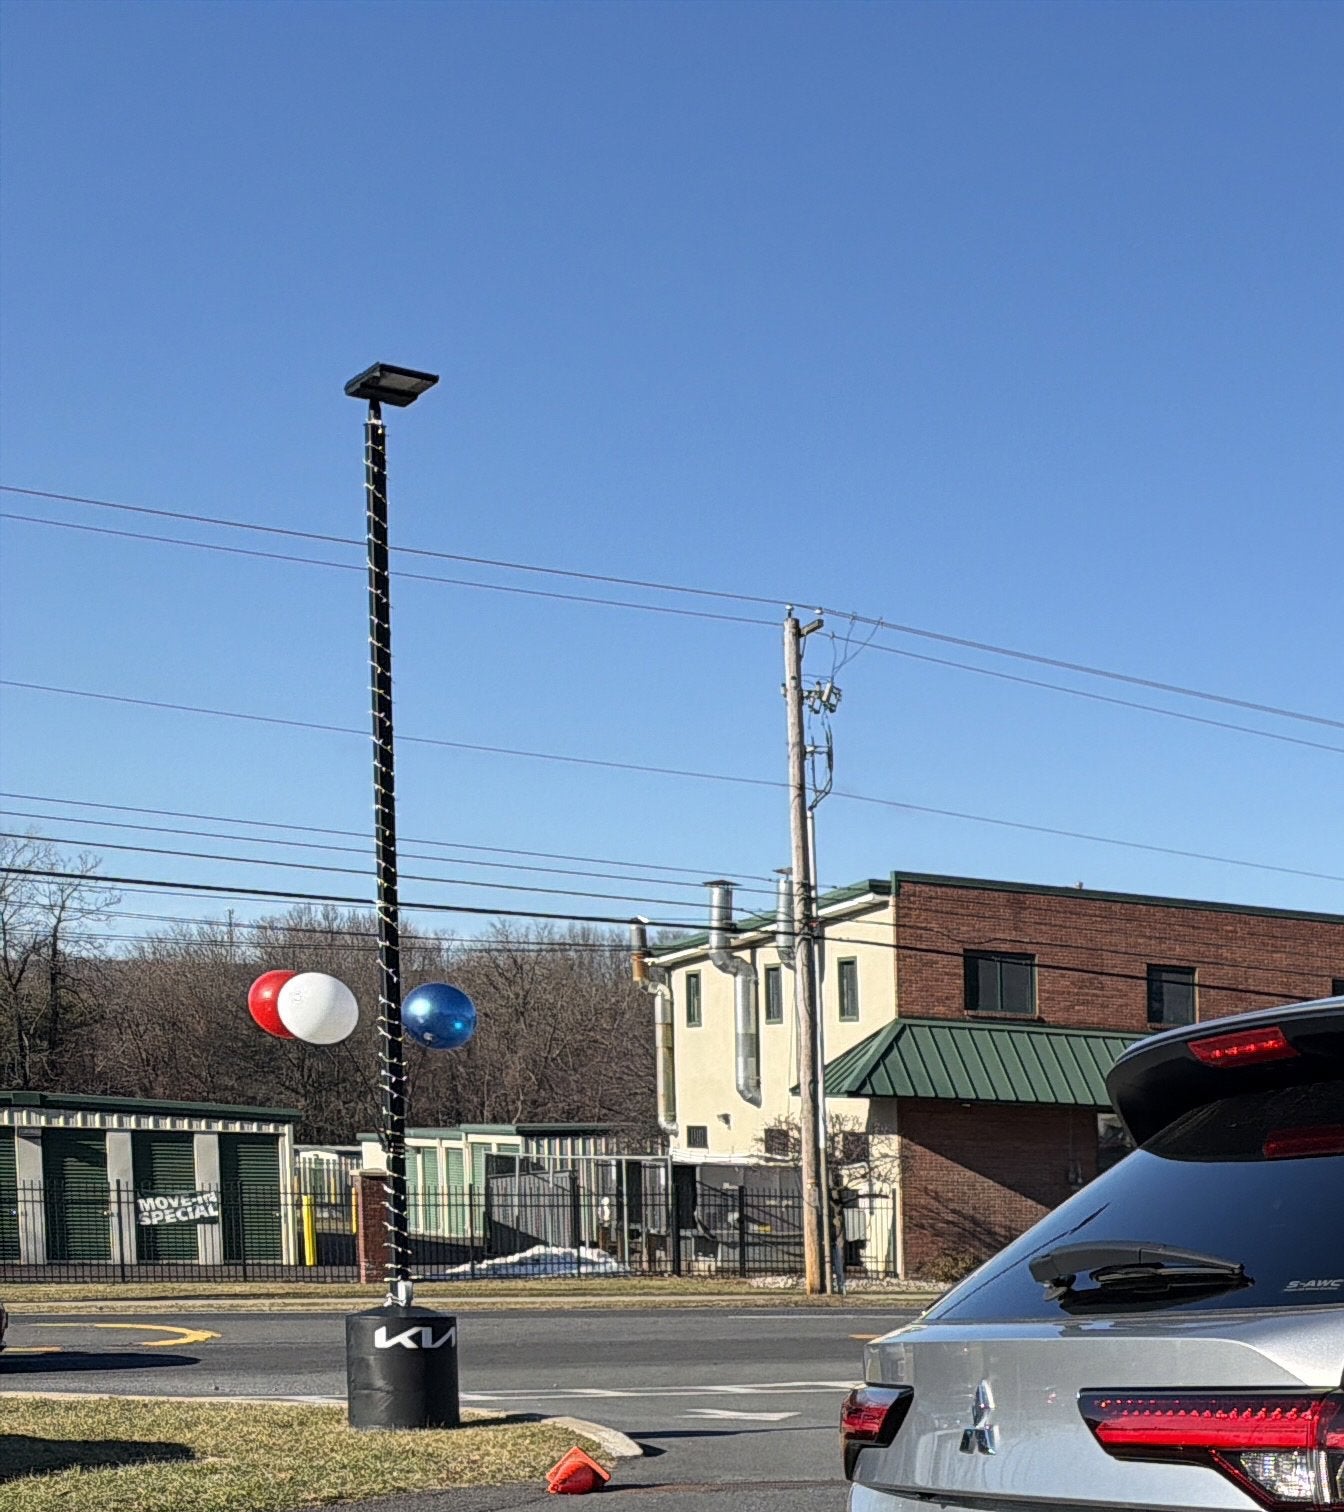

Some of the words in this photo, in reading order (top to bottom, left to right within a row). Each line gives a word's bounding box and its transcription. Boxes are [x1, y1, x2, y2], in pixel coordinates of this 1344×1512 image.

[139, 1202, 219, 1225] SPECIAL
[1286, 1278, 1344, 1288] S-AWC
[374, 1326, 456, 1349] KIA
